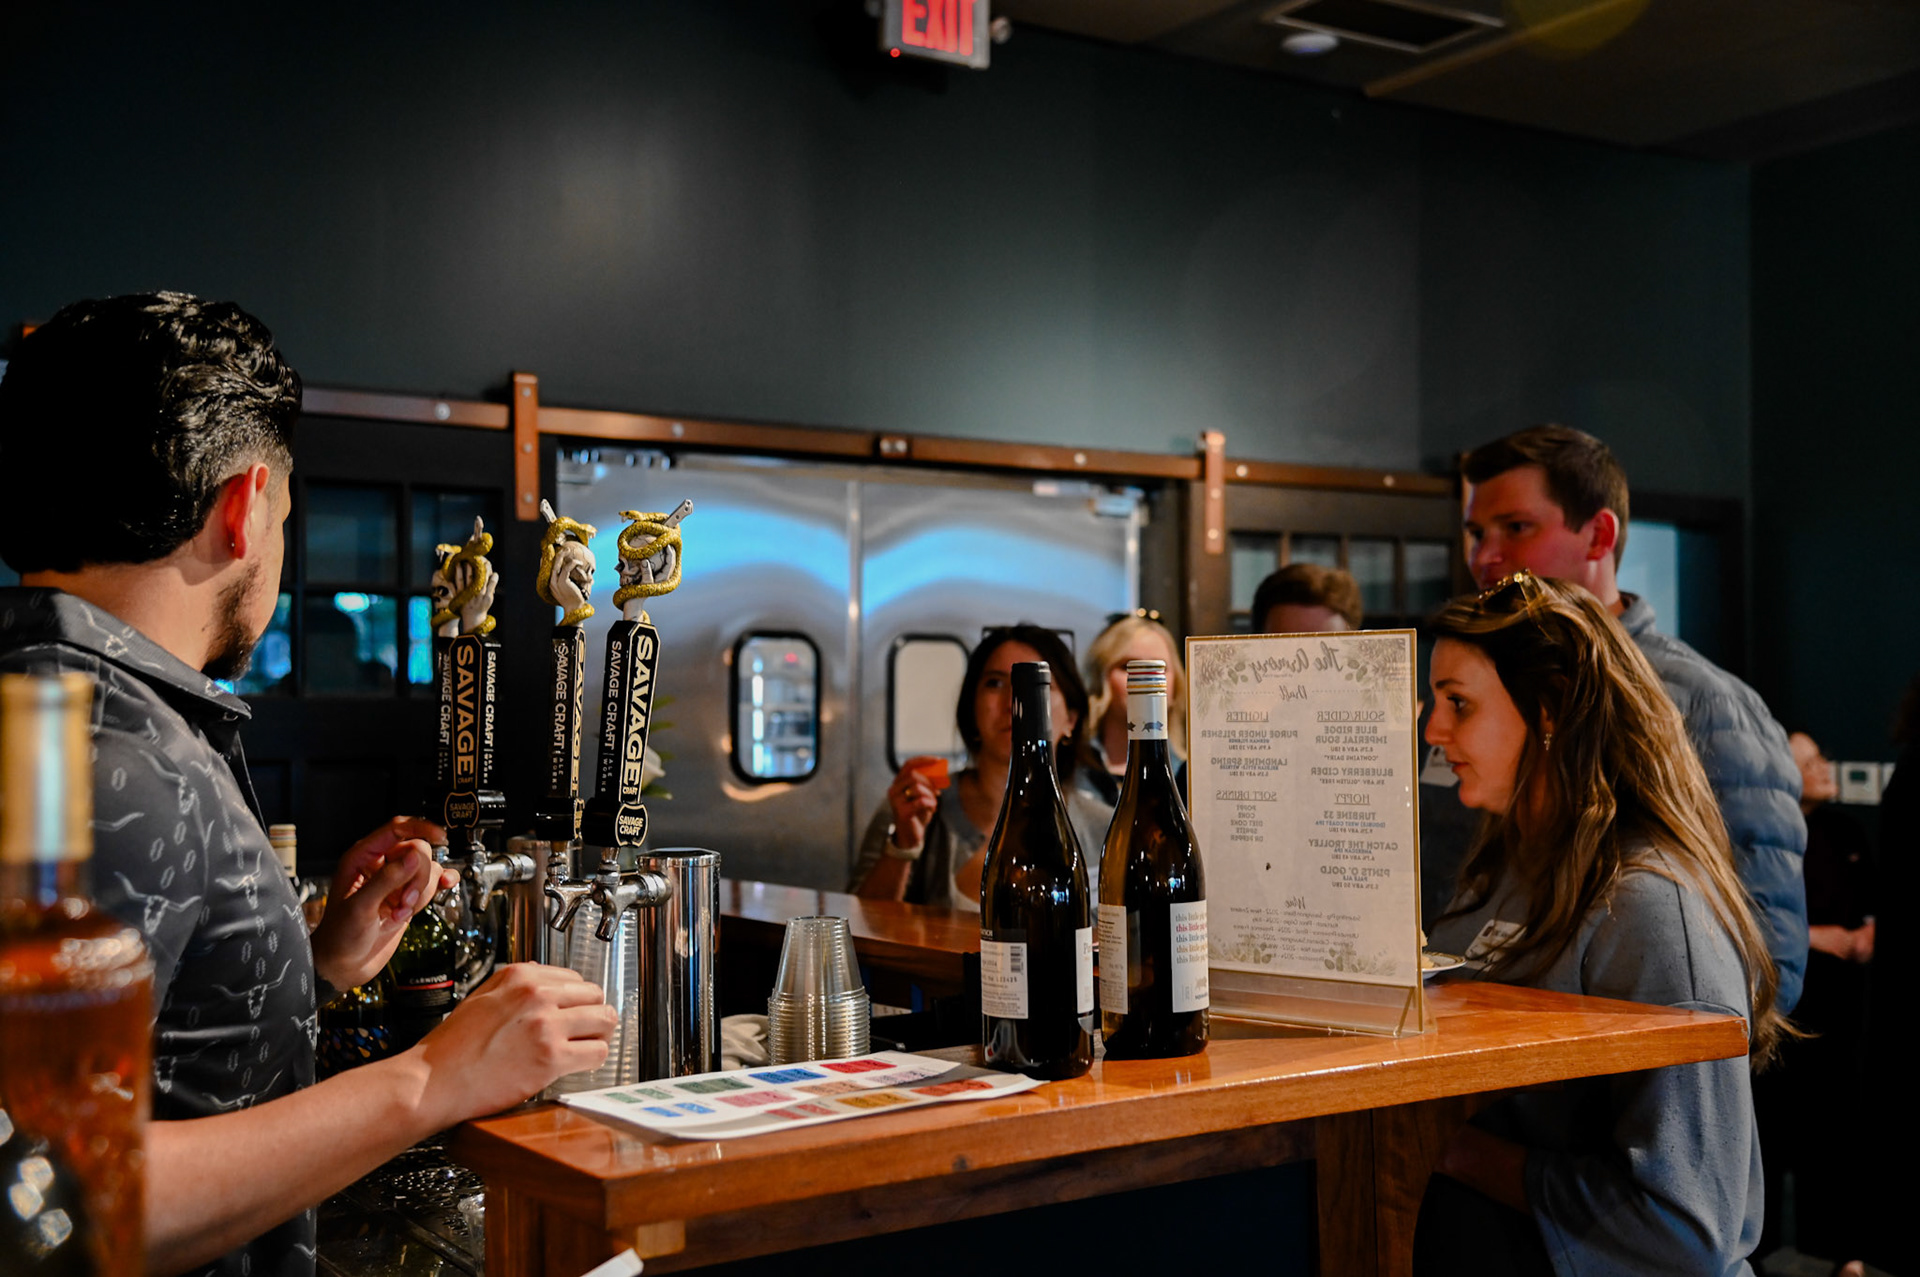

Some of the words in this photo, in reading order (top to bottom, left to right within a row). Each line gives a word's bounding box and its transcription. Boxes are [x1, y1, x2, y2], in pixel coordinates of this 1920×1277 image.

[902, 0, 975, 56] EXIT
[442, 653, 450, 702] SAVAGE
[486, 651, 497, 702] SAVAGE
[556, 645, 569, 700] SAVAGE
[609, 640, 622, 698] SAVAGE
[440, 705, 450, 745] CRAFT
[457, 645, 474, 776] SAVAGE
[484, 704, 495, 747] CRAFT
[553, 703, 567, 750] CRAFT
[604, 702, 618, 751] CRAFT
[623, 634, 654, 787] SAVAGE
[450, 803, 475, 812] SAVAGE
[451, 810, 472, 819] CRAFT
[622, 786, 638, 796] CRAFT
[619, 814, 644, 829] SAVAGE
[619, 824, 641, 837] CRAFT
[409, 974, 448, 984] CARNIVOR
